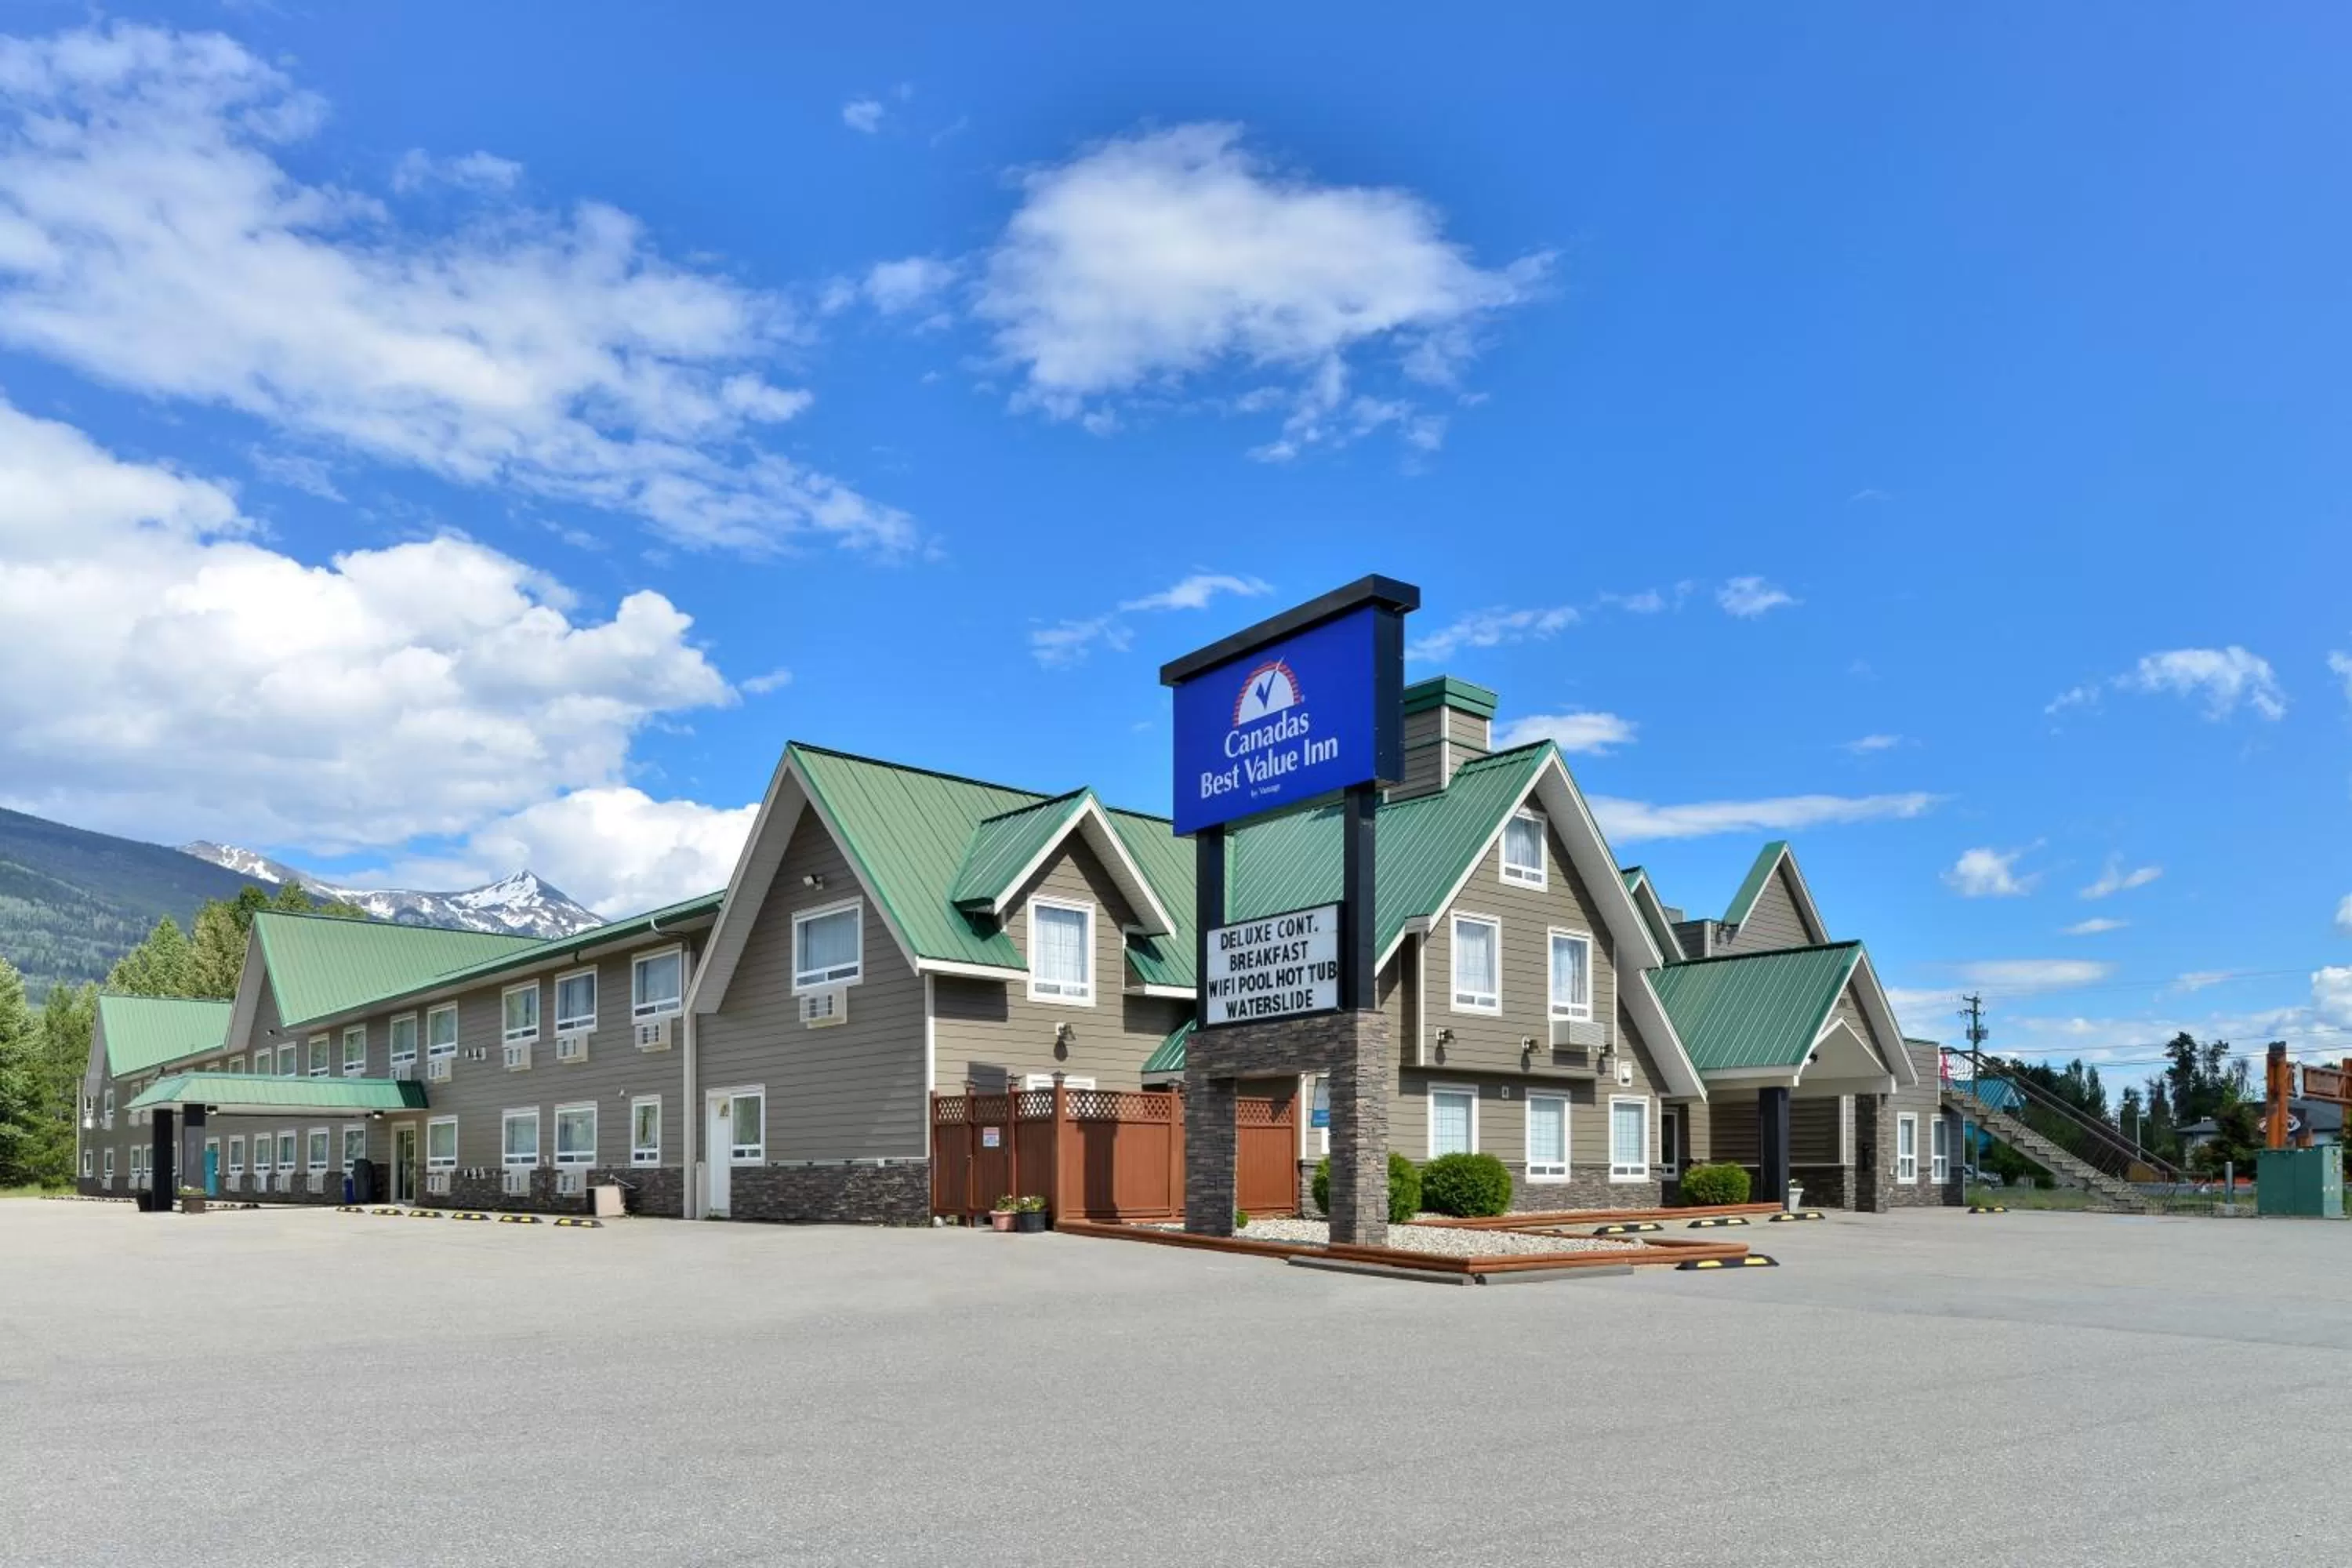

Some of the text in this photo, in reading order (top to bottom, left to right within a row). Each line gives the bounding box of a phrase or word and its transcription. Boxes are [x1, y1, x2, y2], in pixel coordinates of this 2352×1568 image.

[1224, 711, 1310, 759] Canadas
[1200, 737, 1339, 800] Best Value Inn
[1221, 914, 1319, 950] DELUXE CONT.
[1230, 941, 1308, 971] BREAKFAST
[1208, 960, 1338, 998] WIFI POOL HOT TUB
[1226, 989, 1313, 1018] WATERSLIDE
